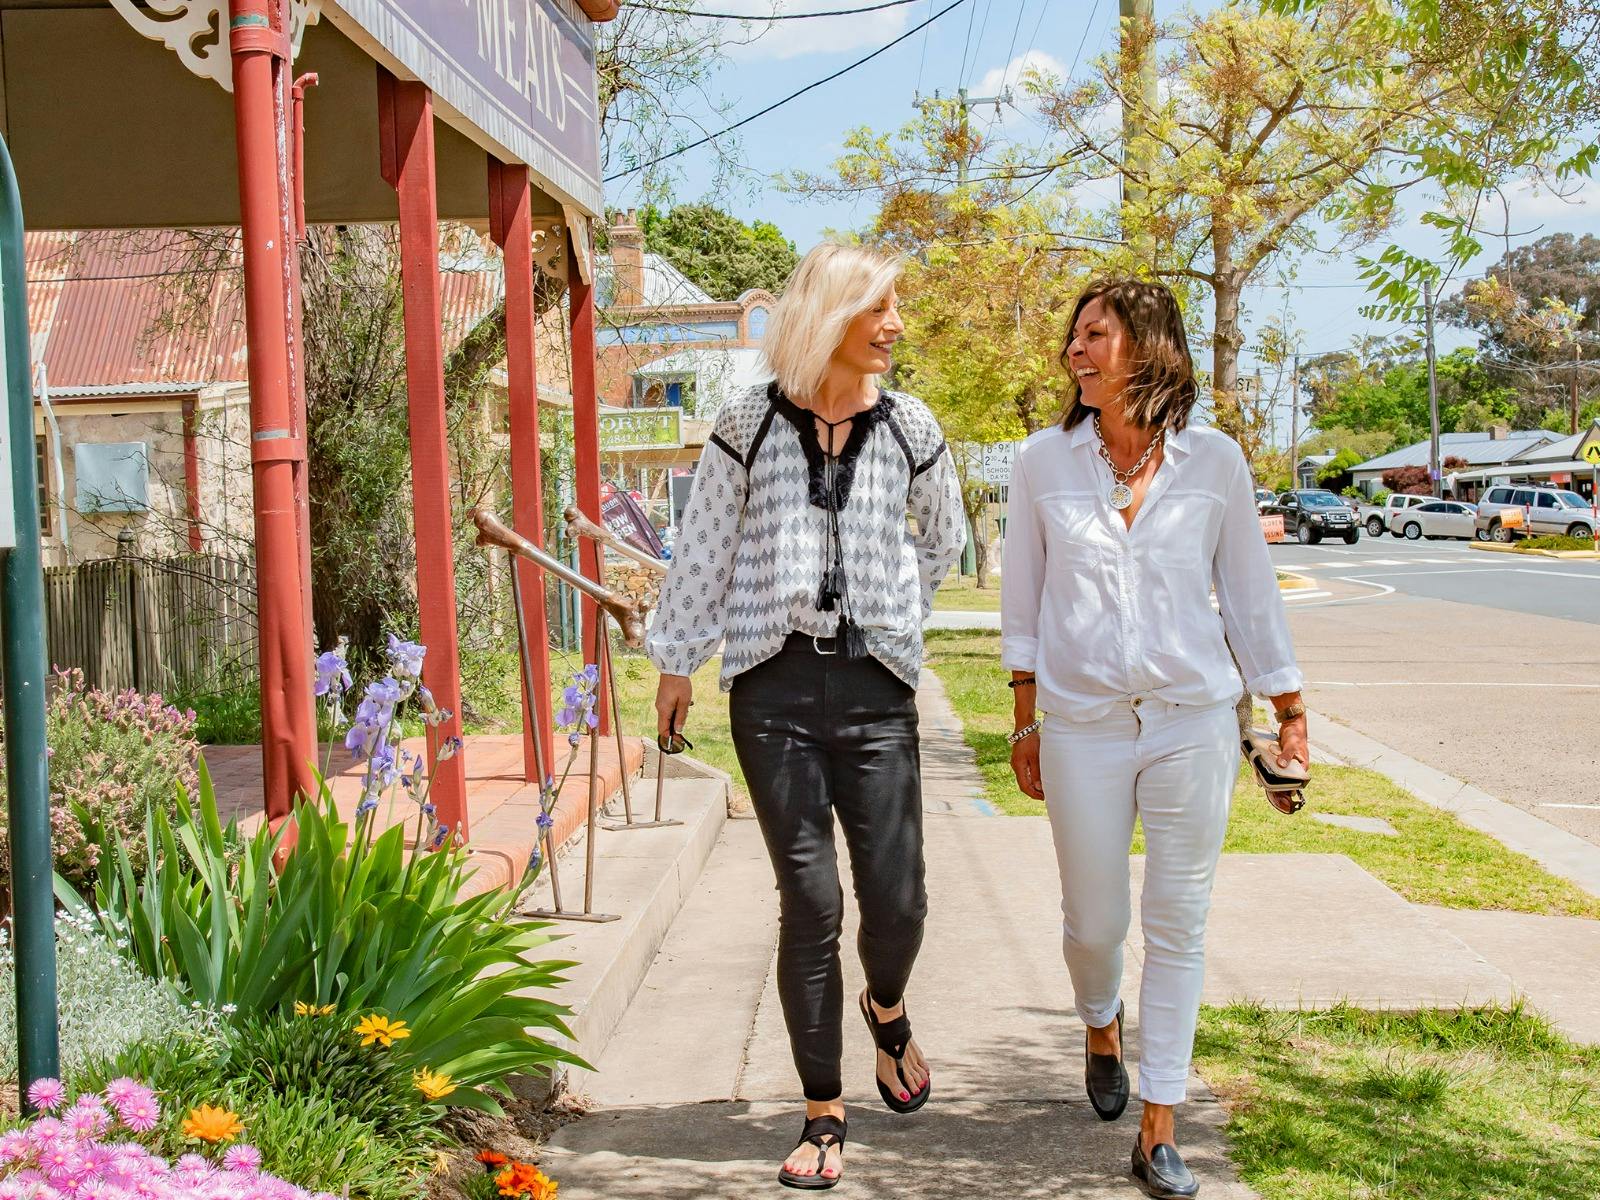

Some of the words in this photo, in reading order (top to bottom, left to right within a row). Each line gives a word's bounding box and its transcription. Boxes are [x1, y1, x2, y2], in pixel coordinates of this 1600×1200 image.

[477, 0, 565, 132] MEATS
[599, 416, 673, 431] ORIST
[1262, 519, 1283, 527] ILDREN
